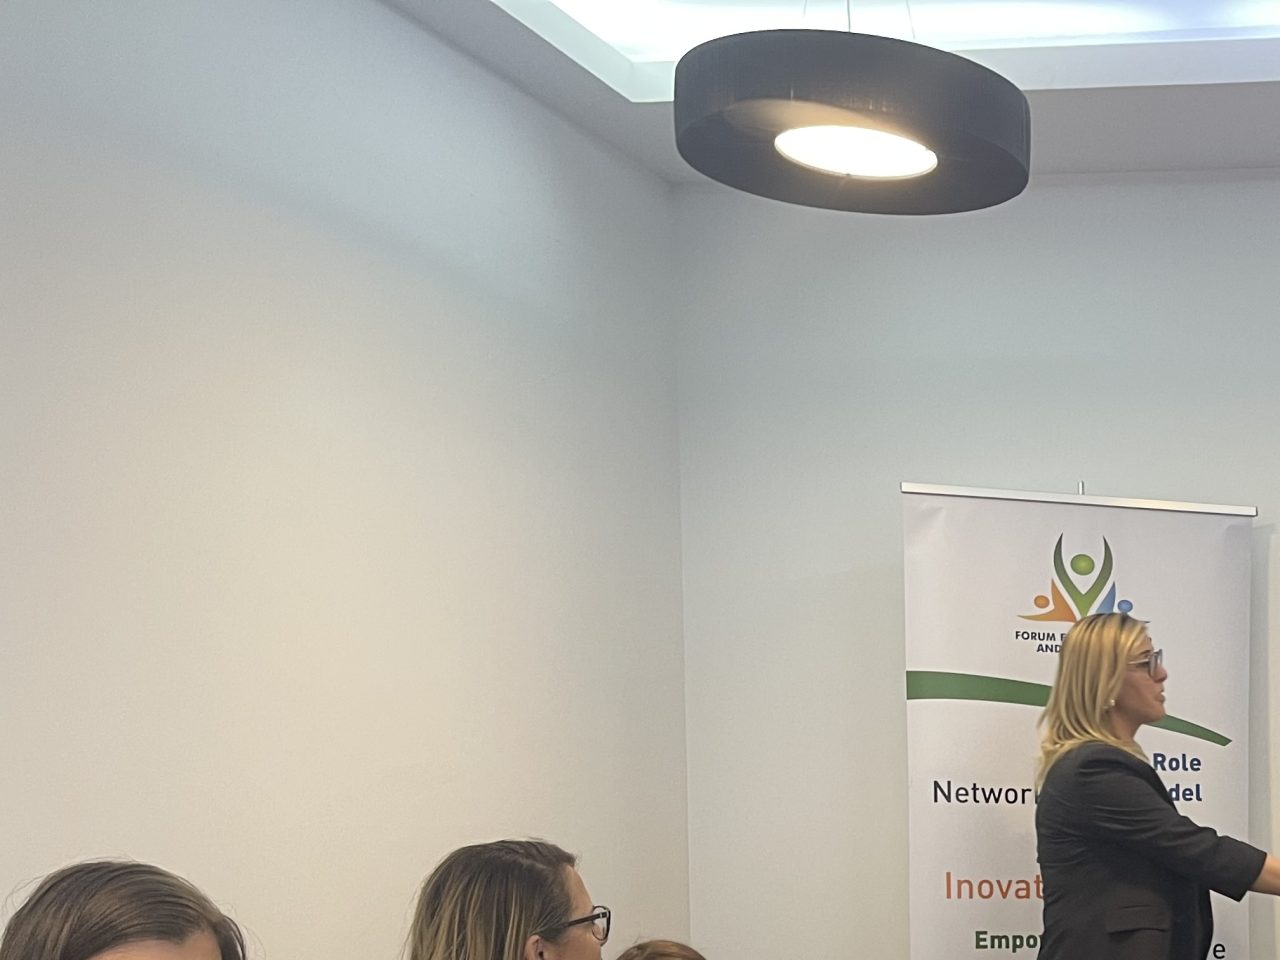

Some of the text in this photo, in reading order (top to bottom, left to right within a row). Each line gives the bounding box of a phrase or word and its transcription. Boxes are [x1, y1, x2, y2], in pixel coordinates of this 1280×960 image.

[1015, 630, 1056, 641] FORUM
[1036, 643, 1062, 653] AND
[1153, 753, 1202, 772] Role
[933, 780, 1039, 805] Networ
[1168, 783, 1203, 802] del
[945, 871, 1044, 900] Inovat
[975, 930, 1042, 954] Empo
